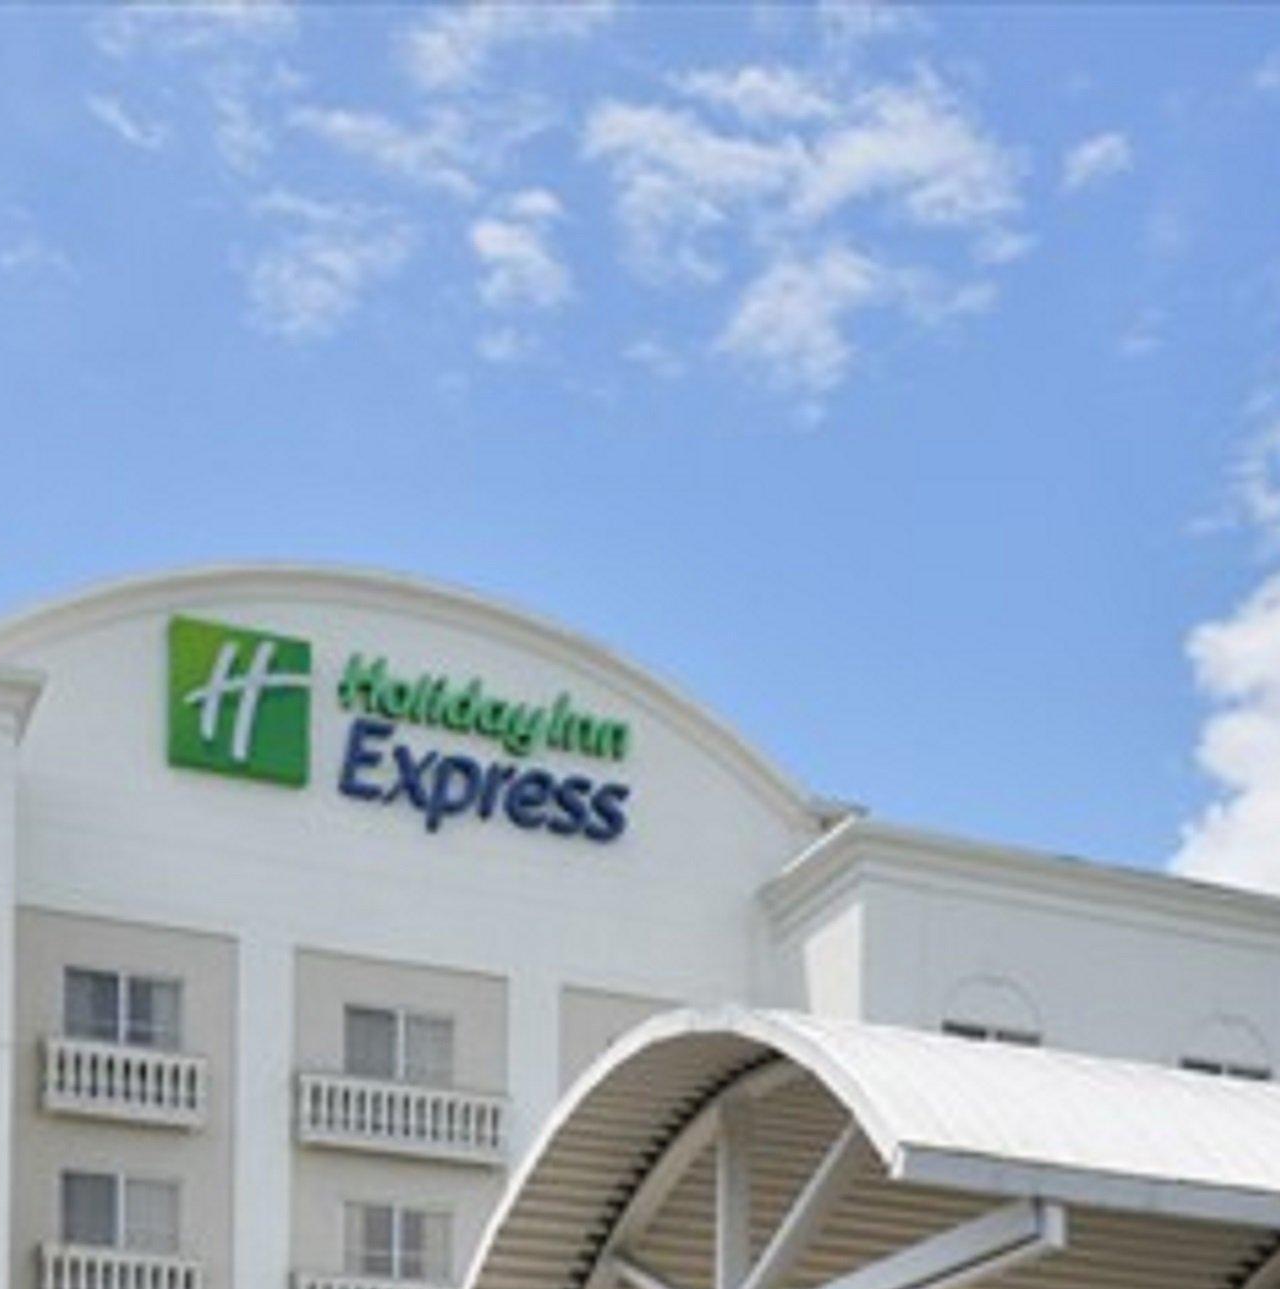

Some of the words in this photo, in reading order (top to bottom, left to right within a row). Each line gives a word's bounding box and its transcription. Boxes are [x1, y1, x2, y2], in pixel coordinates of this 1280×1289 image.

[337, 653, 544, 756] Holiday
[545, 691, 630, 761] Inn
[337, 717, 631, 843] Express
